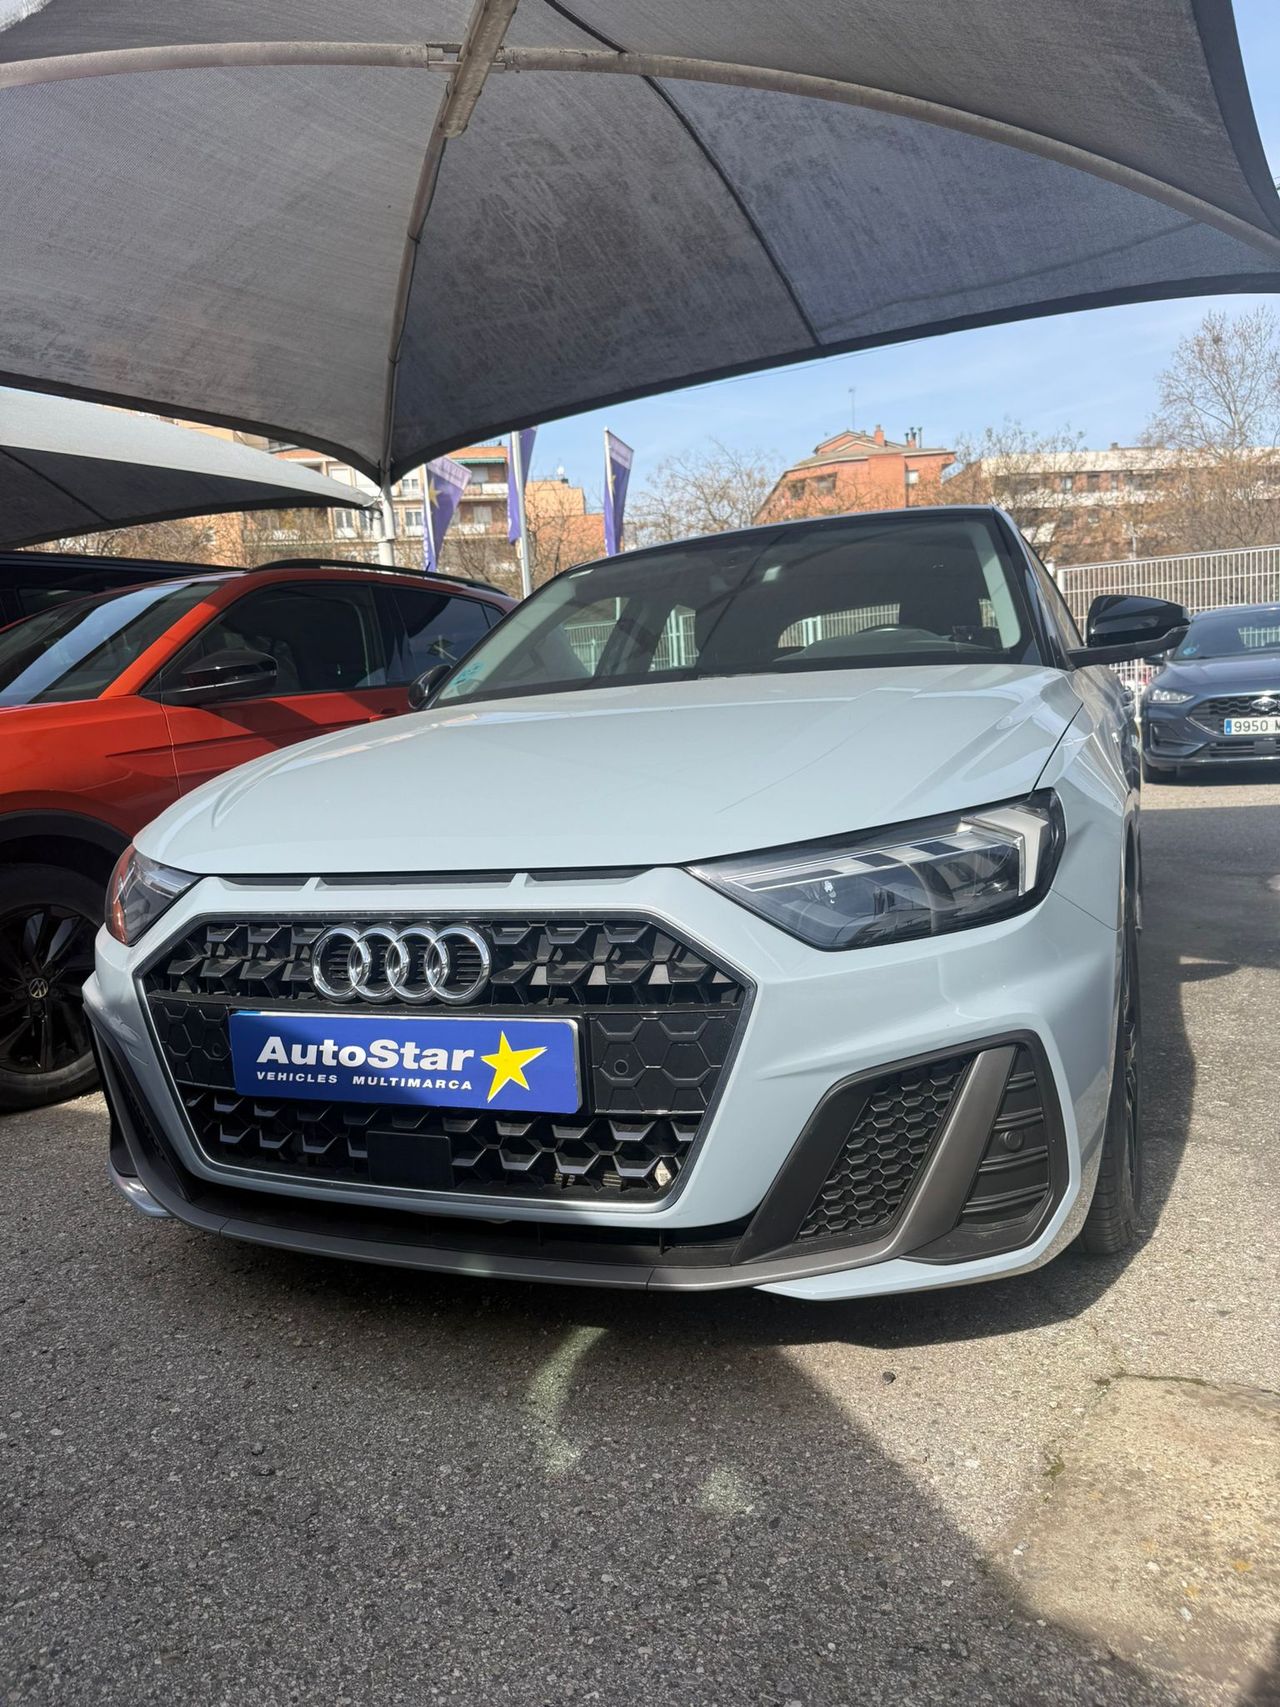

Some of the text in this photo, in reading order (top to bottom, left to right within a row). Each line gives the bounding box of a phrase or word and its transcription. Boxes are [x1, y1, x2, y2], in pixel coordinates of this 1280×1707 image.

[1233, 719, 1269, 733] 9950
[256, 1035, 475, 1072] AutoStar
[256, 1071, 473, 1090] VEHICLES MULTIMARCA
